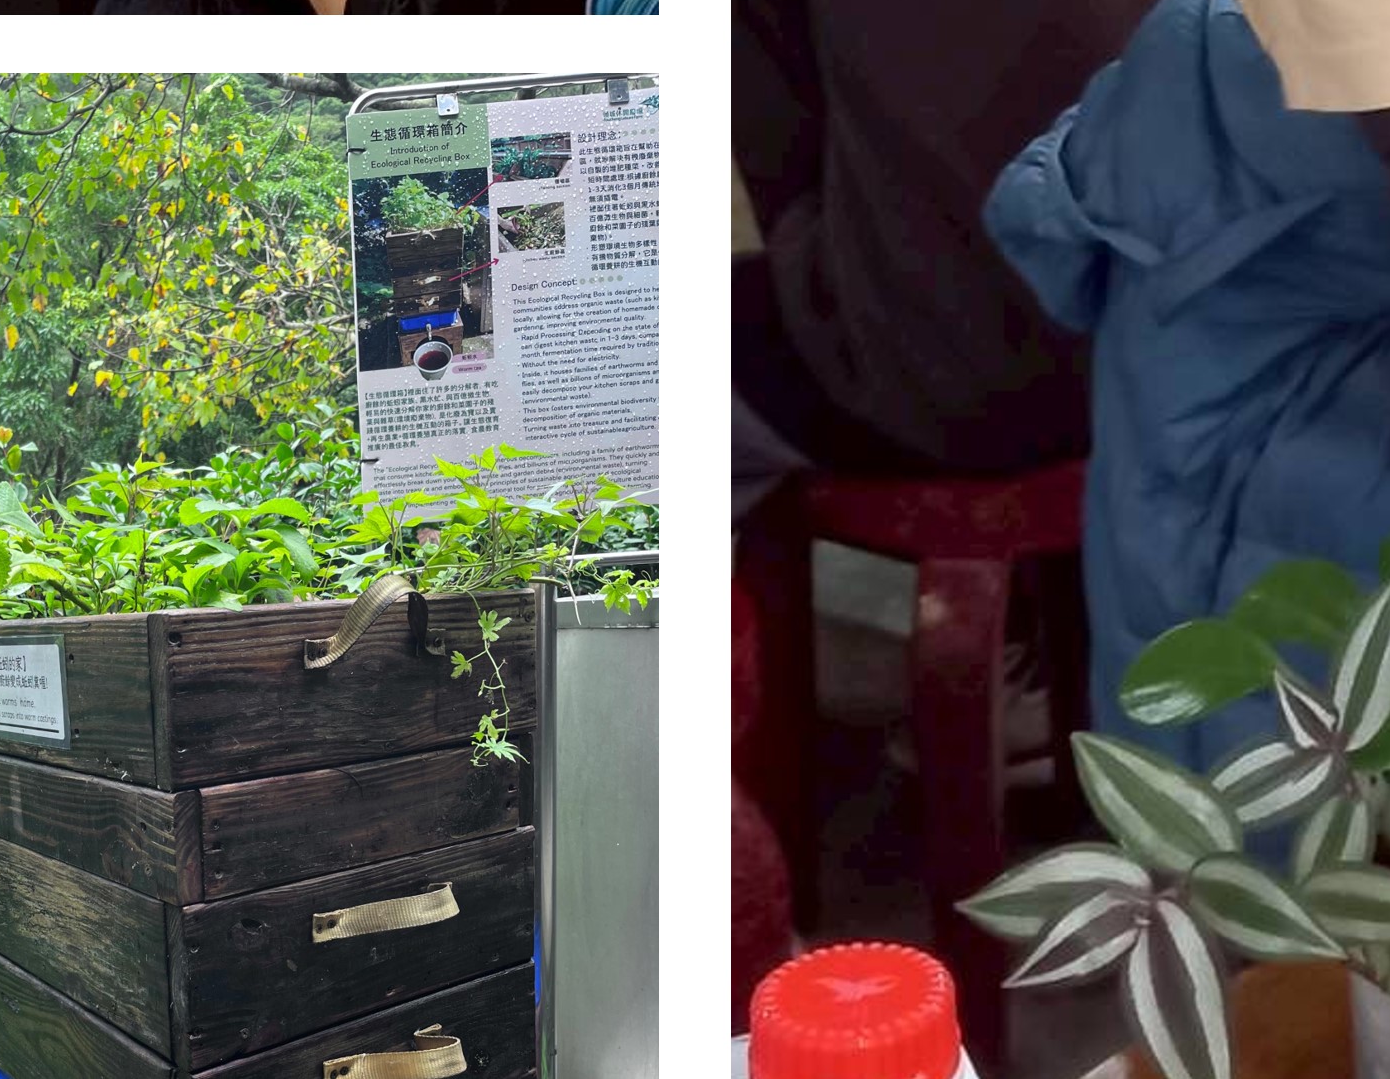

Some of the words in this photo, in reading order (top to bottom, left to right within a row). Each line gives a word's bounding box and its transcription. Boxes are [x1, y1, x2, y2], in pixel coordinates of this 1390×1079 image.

[370, 122, 468, 142] 生態循環箱簡介
[390, 145, 439, 155] Introduction
[441, 143, 449, 151] of
[371, 158, 411, 169] Ecological
[413, 154, 452, 165] Recycling
[455, 153, 471, 161] Box
[511, 281, 538, 291] Design
[541, 278, 577, 288] Concept:
[527, 294, 559, 303] Ecological
[561, 292, 591, 301] Recycling
[614, 287, 642, 296] designed
[512, 304, 551, 313] communities
[580, 299, 602, 308] organic
[625, 296, 641, 305] (such
[536, 312, 560, 320] allowing
[585, 308, 611, 316] creation
[621, 304, 654, 313] homemade
[546, 320, 576, 329] improving
[578, 315, 621, 325] environmental
[521, 332, 538, 341] Rapid
[578, 327, 611, 336] Depending
[533, 340, 552, 349] digest
[554, 338, 577, 346] kitchen
[579, 336, 597, 344] waste
[520, 350, 540, 358] month
[542, 347, 582, 356] fermentation
[599, 342, 625, 352] required
[627, 342, 634, 350] by
[521, 360, 545, 368] Without
[587, 353, 620, 362] electricity.
[574, 365, 597, 373] families
[607, 362, 644, 370] earthworms
[602, 370, 650, 379] microorganisms
[522, 388, 539, 396] easily
[578, 384, 591, 392] your
[594, 381, 617, 389] kitchen
[522, 394, 567, 405] (environmental
[575, 399, 619, 409] environmental
[620, 395, 656, 404] biodiversity
[522, 413, 567, 422] decomposition
[577, 409, 600, 418] organic
[523, 424, 546, 432] Turning
[624, 414, 656, 423] facilitating
[525, 432, 558, 440] interactive
[560, 430, 576, 438] cycle
[625, 451, 646, 460] quickly
[373, 480, 406, 488] effortlessly
[513, 469, 534, 477] garden
[556, 463, 601, 474] (environmental
[527, 474, 561, 482] sustainable
[610, 466, 641, 475] ecological
[20, 697, 35, 708] home.
